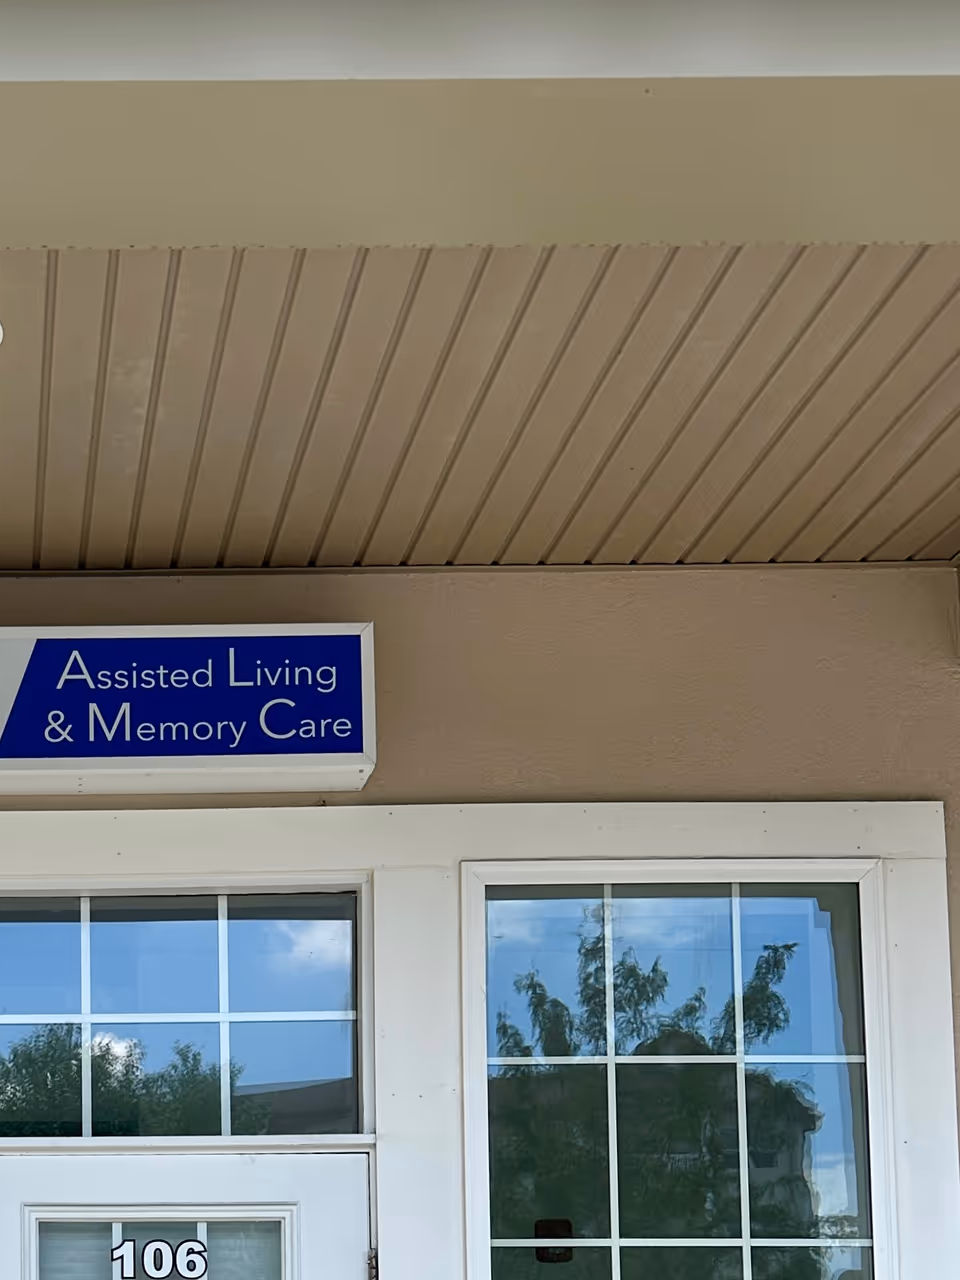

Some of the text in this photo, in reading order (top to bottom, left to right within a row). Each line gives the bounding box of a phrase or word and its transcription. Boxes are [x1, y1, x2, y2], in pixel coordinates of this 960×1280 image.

[57, 647, 338, 694] Assisted Living
[44, 700, 352, 750] & Memory Care
[111, 1239, 208, 1280] 106
